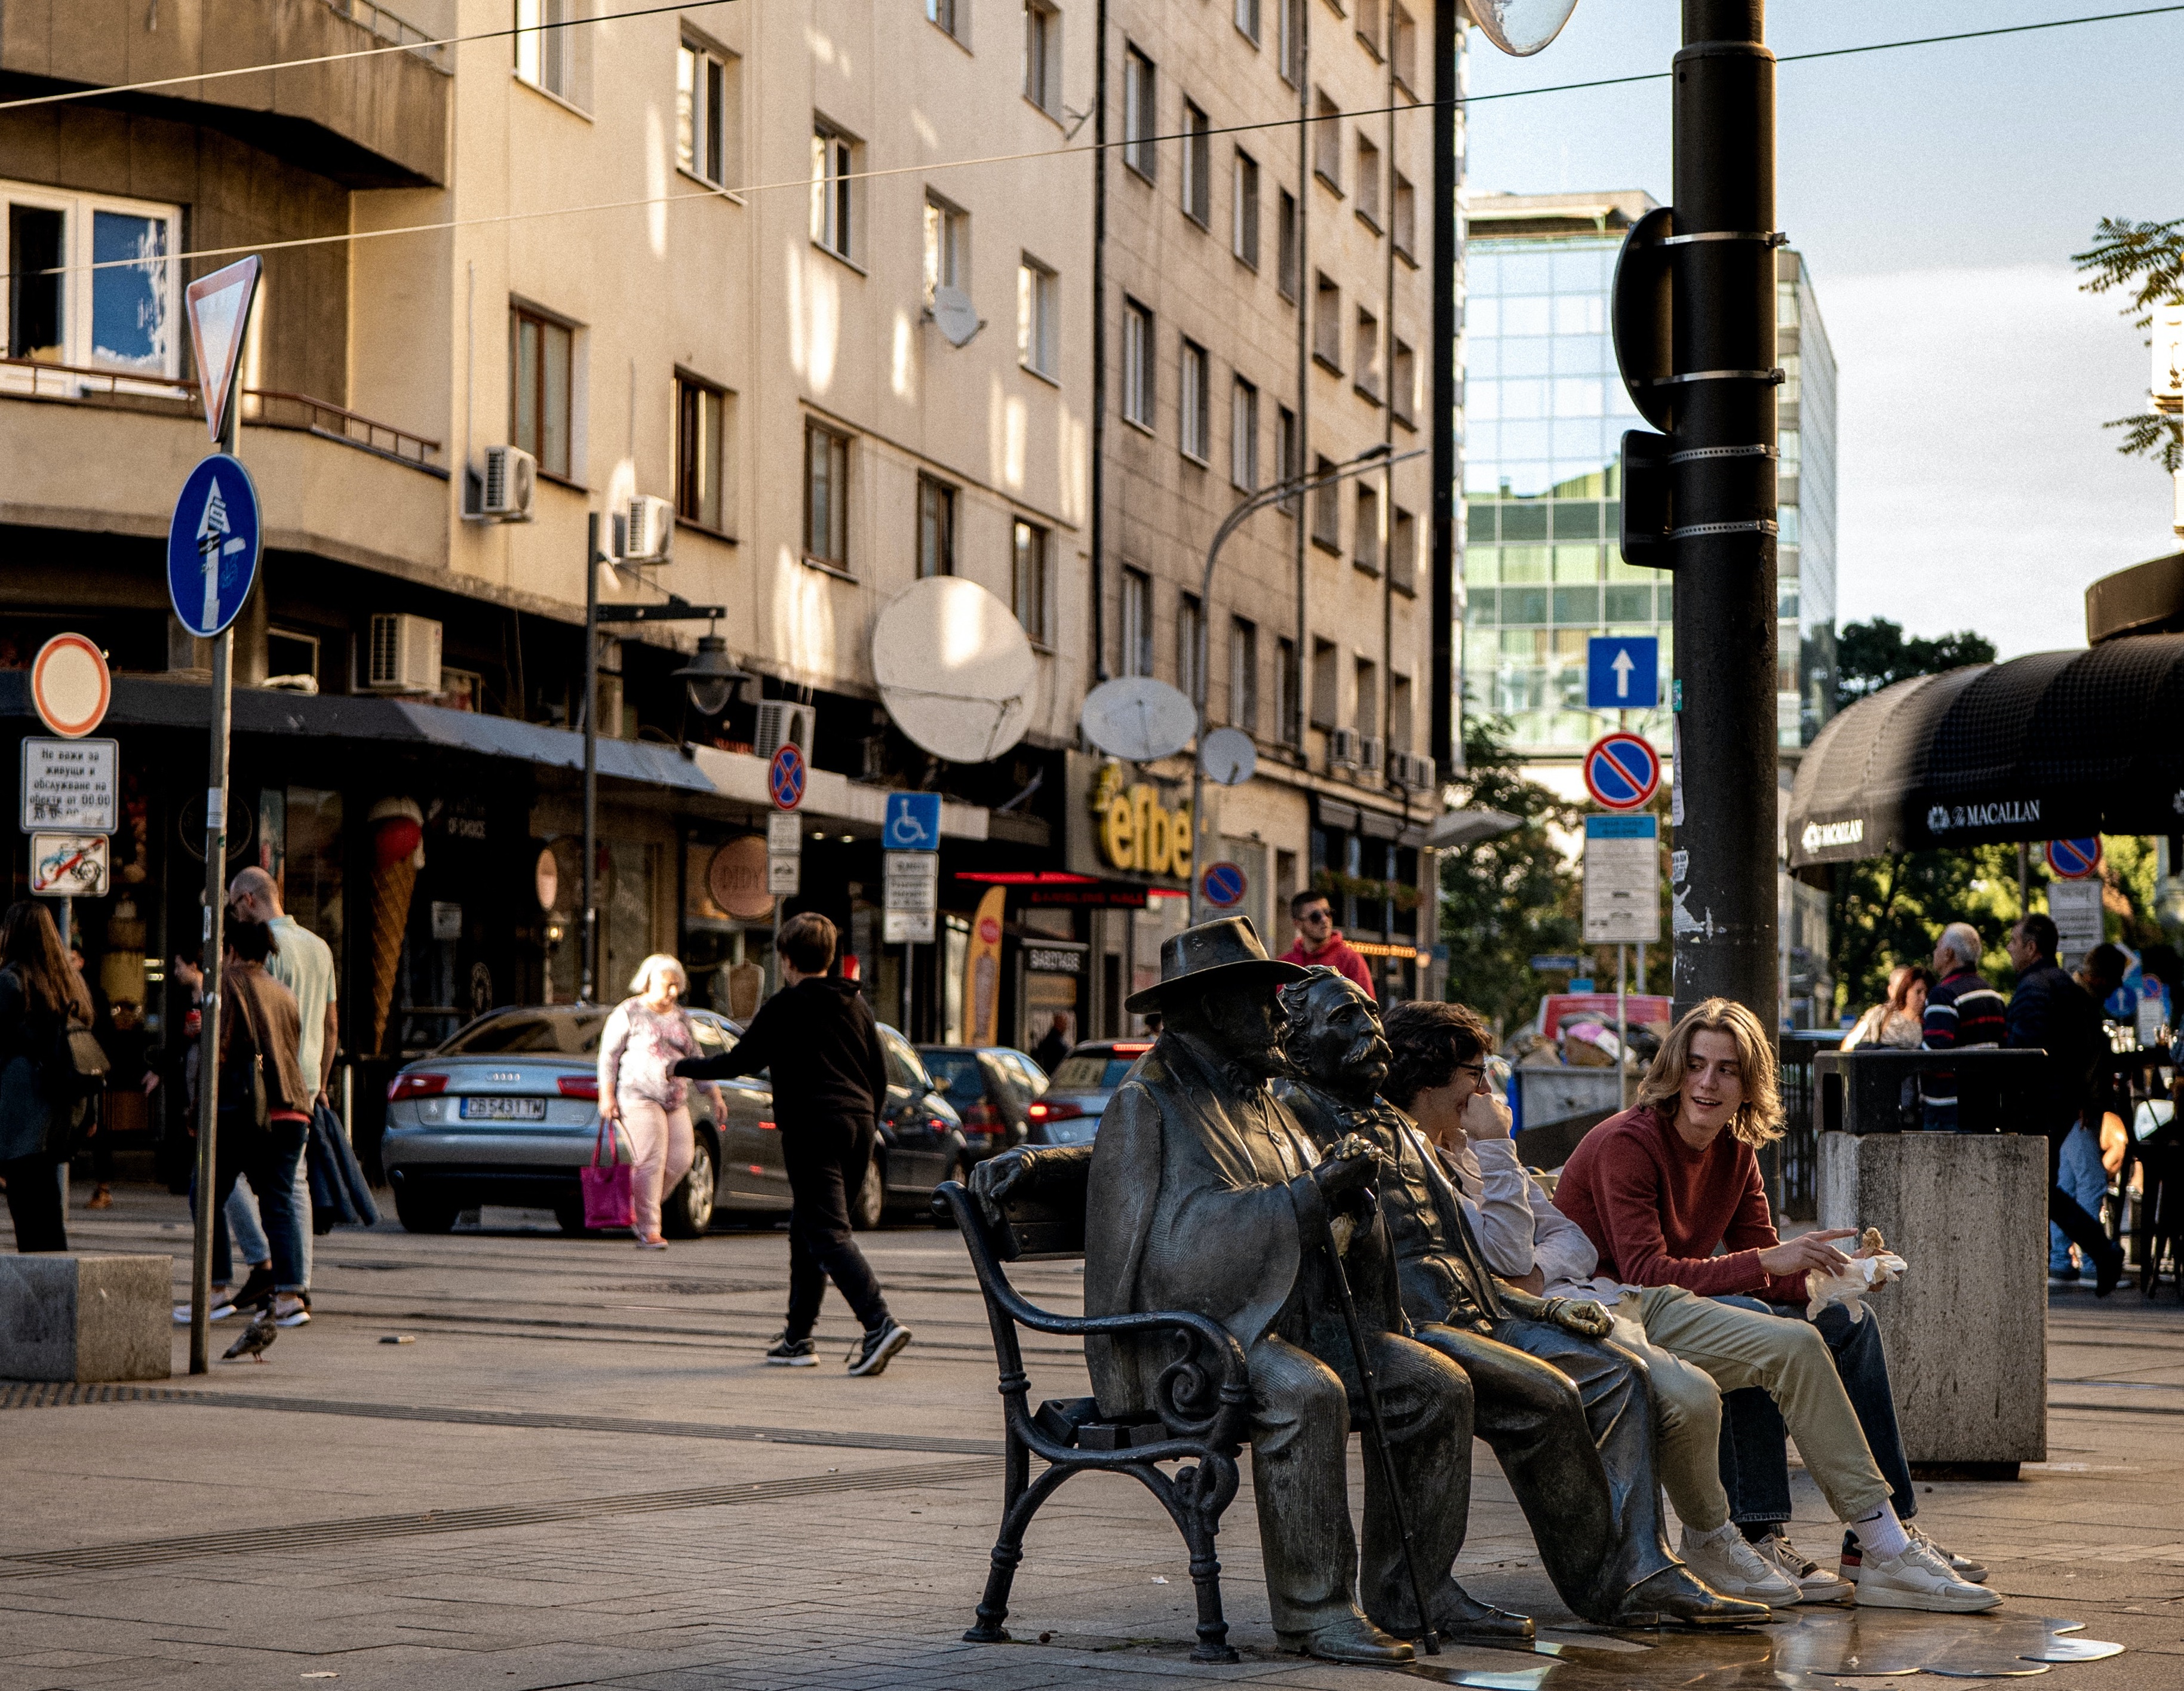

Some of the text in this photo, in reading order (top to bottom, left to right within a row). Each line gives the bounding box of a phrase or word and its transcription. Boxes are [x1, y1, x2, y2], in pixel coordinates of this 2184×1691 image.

[42, 749, 100, 761] Не важи за
[46, 765, 95, 777] живущи и
[34, 779, 106, 792] обслужване на
[30, 793, 110, 806] обекти от 00.00
[1967, 800, 2040, 827] MACALLAN
[1100, 782, 1208, 880] efbe
